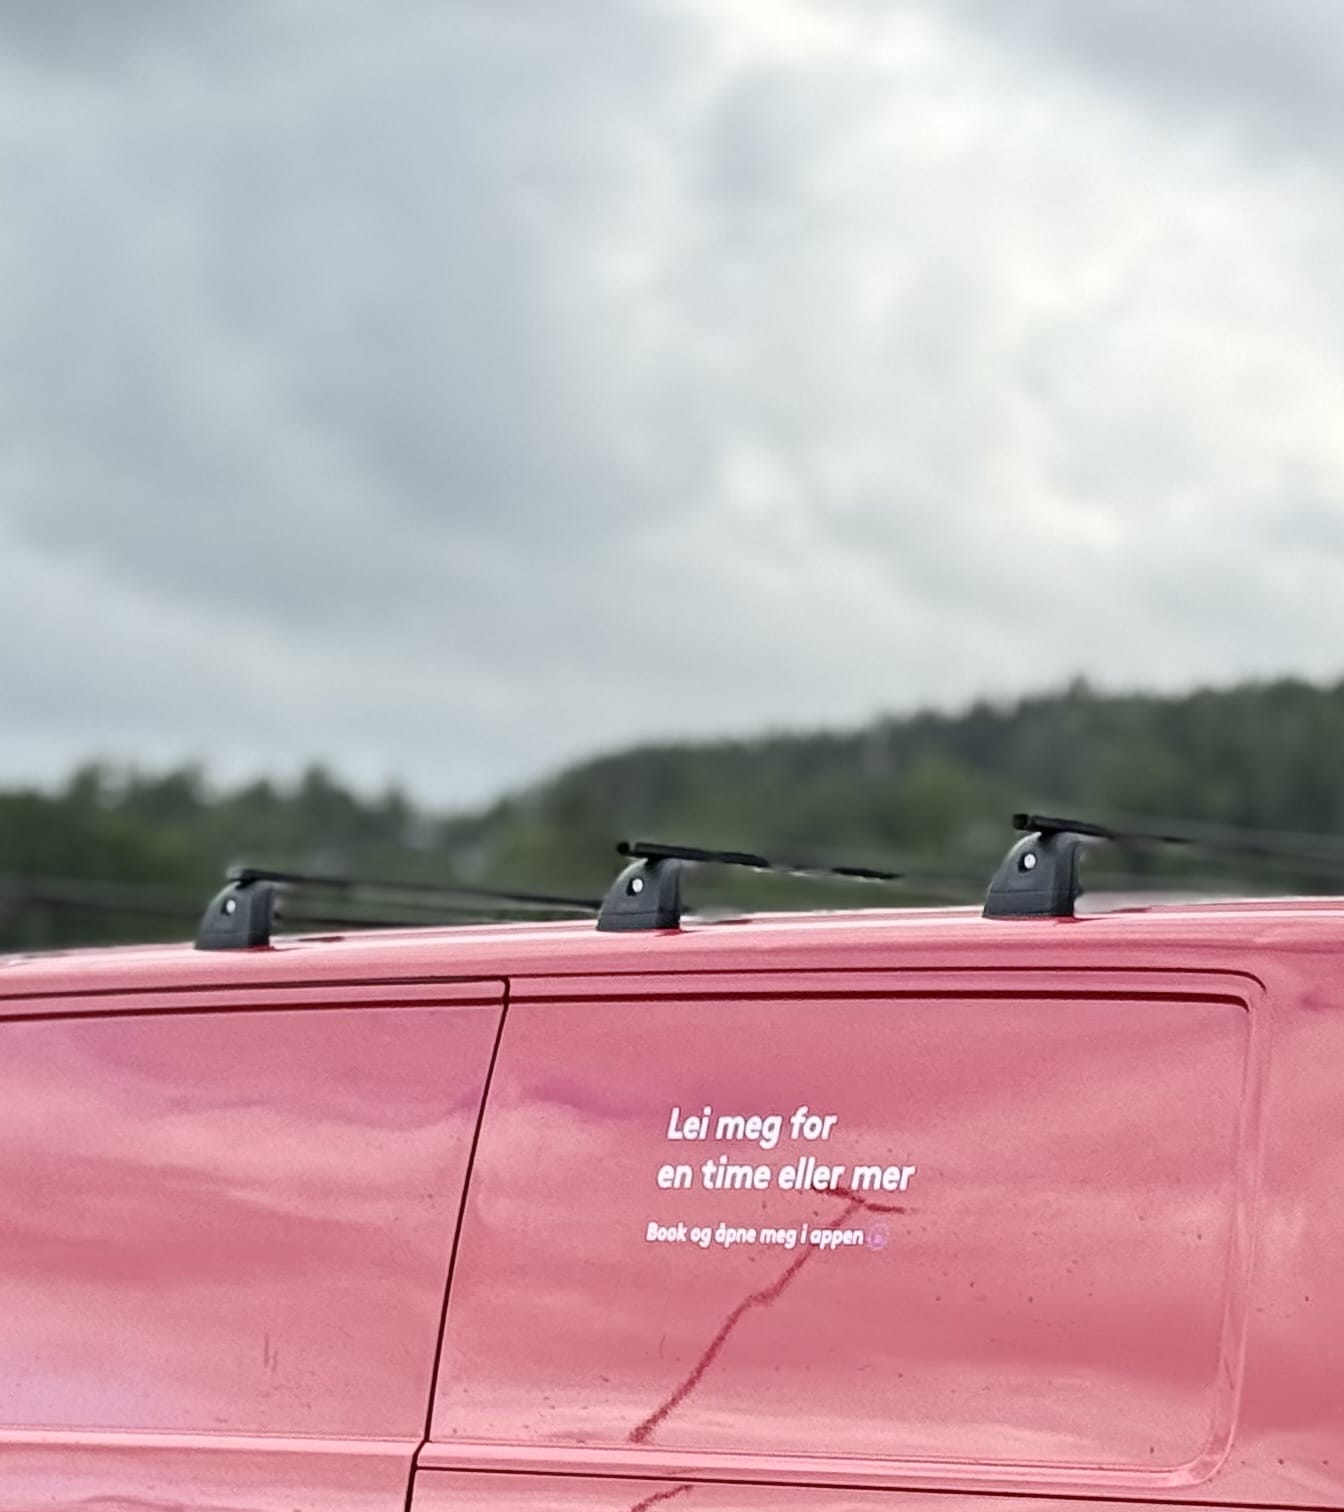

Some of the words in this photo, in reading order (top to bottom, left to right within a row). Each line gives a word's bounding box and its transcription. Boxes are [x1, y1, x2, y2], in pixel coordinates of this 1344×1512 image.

[667, 1106, 712, 1140] Lei
[715, 1114, 782, 1149] meg
[790, 1106, 838, 1140] for
[657, 1164, 693, 1190] en
[701, 1155, 771, 1190] time
[778, 1156, 845, 1190] eller
[851, 1164, 916, 1191] mer
[646, 1222, 688, 1242] Book
[690, 1227, 712, 1248] og
[714, 1223, 756, 1248] åpne
[759, 1228, 797, 1249] meg
[800, 1224, 808, 1244] i
[810, 1228, 864, 1250] appen
